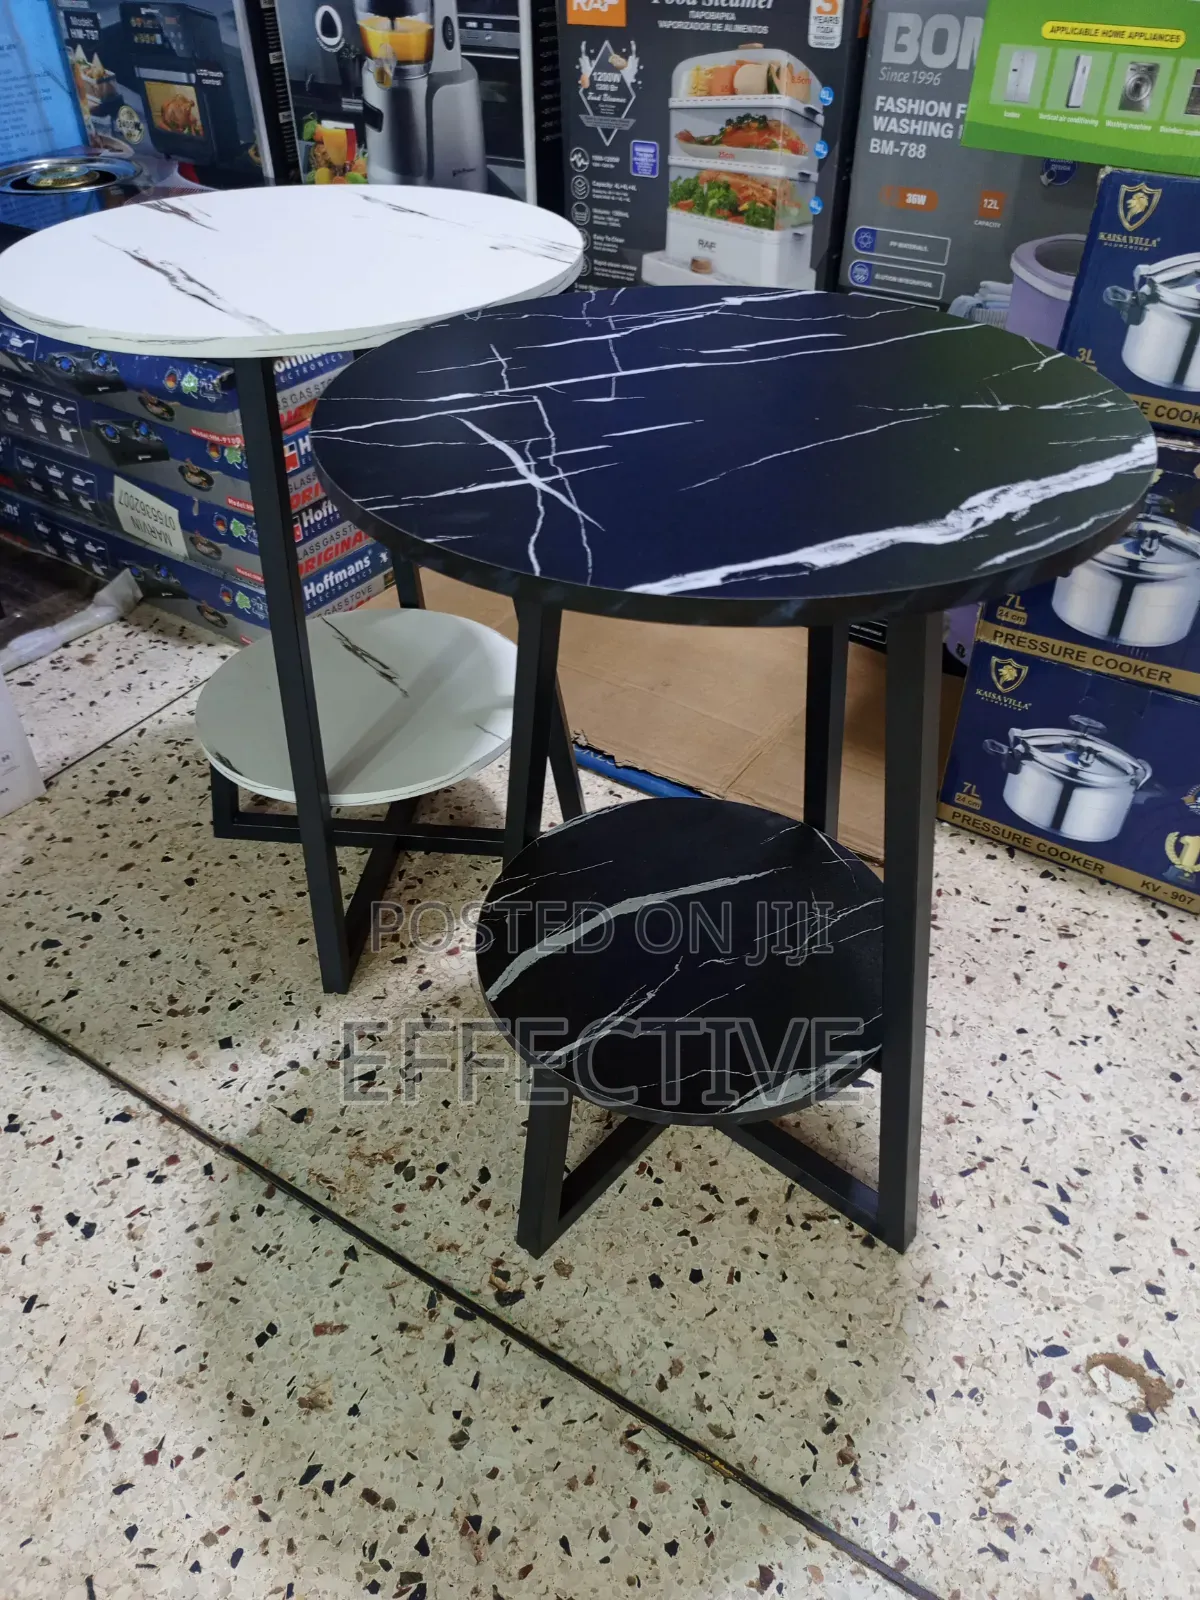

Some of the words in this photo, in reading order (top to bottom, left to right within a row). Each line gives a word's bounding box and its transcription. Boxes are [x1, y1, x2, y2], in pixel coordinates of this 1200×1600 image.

[812, 16, 841, 25] YEARS
[1049, 25, 1100, 37] APPLICABLE
[1101, 29, 1126, 39] HOME
[1127, 32, 1181, 43] APPLIANCES
[879, 66, 910, 83] Since
[911, 70, 942, 86] 1996
[875, 95, 952, 118] FASHION
[873, 115, 954, 139] WASHING
[869, 137, 927, 159] BM-788
[983, 198, 1000, 210] 12L
[973, 219, 1002, 229] CAPACITY
[1075, 347, 1096, 364] 3L
[130, 516, 173, 548] MARVIN
[303, 556, 372, 602] Hoffmans
[307, 569, 373, 610] ELECTRONICS
[1005, 593, 1026, 611] 7L
[998, 609, 1010, 618] 24
[1010, 612, 1026, 623] cm
[992, 630, 1088, 663] PRESSURE
[1091, 654, 1173, 684] COOKER
[975, 688, 1002, 702] KAISA
[1002, 695, 1030, 710] VILLA
[962, 782, 980, 798] 7L
[967, 799, 981, 809] cm
[951, 811, 1033, 848] PRESSURE
[1036, 842, 1106, 875] COOKER
[1140, 880, 1162, 893] KV
[1170, 891, 1196, 906] 907
